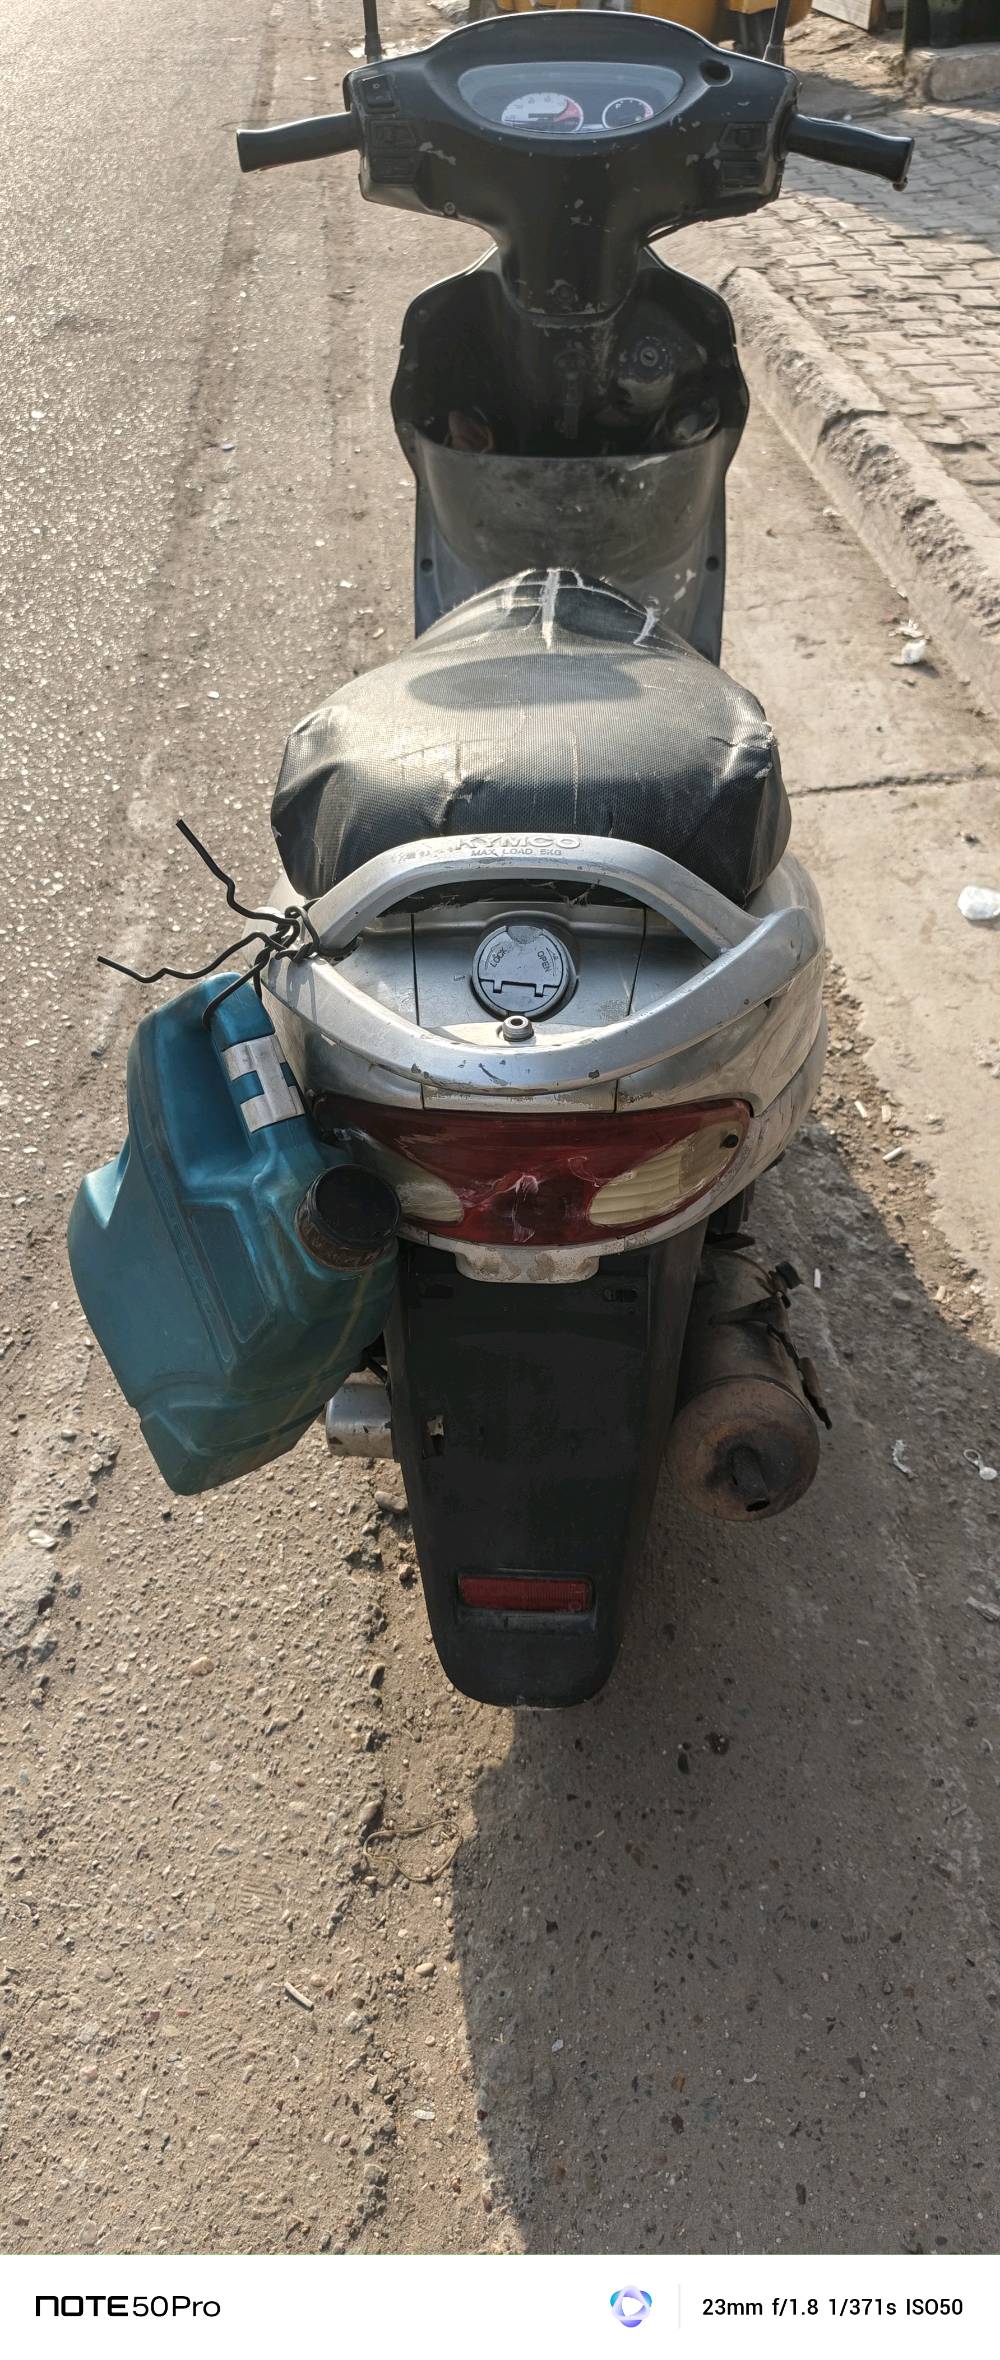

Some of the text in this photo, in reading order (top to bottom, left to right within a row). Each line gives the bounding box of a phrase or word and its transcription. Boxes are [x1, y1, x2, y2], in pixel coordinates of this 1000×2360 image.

[455, 836, 581, 851] KYMCO
[502, 848, 533, 856] LOAD
[489, 947, 508, 968] LOCK
[537, 950, 552, 973] OPEN
